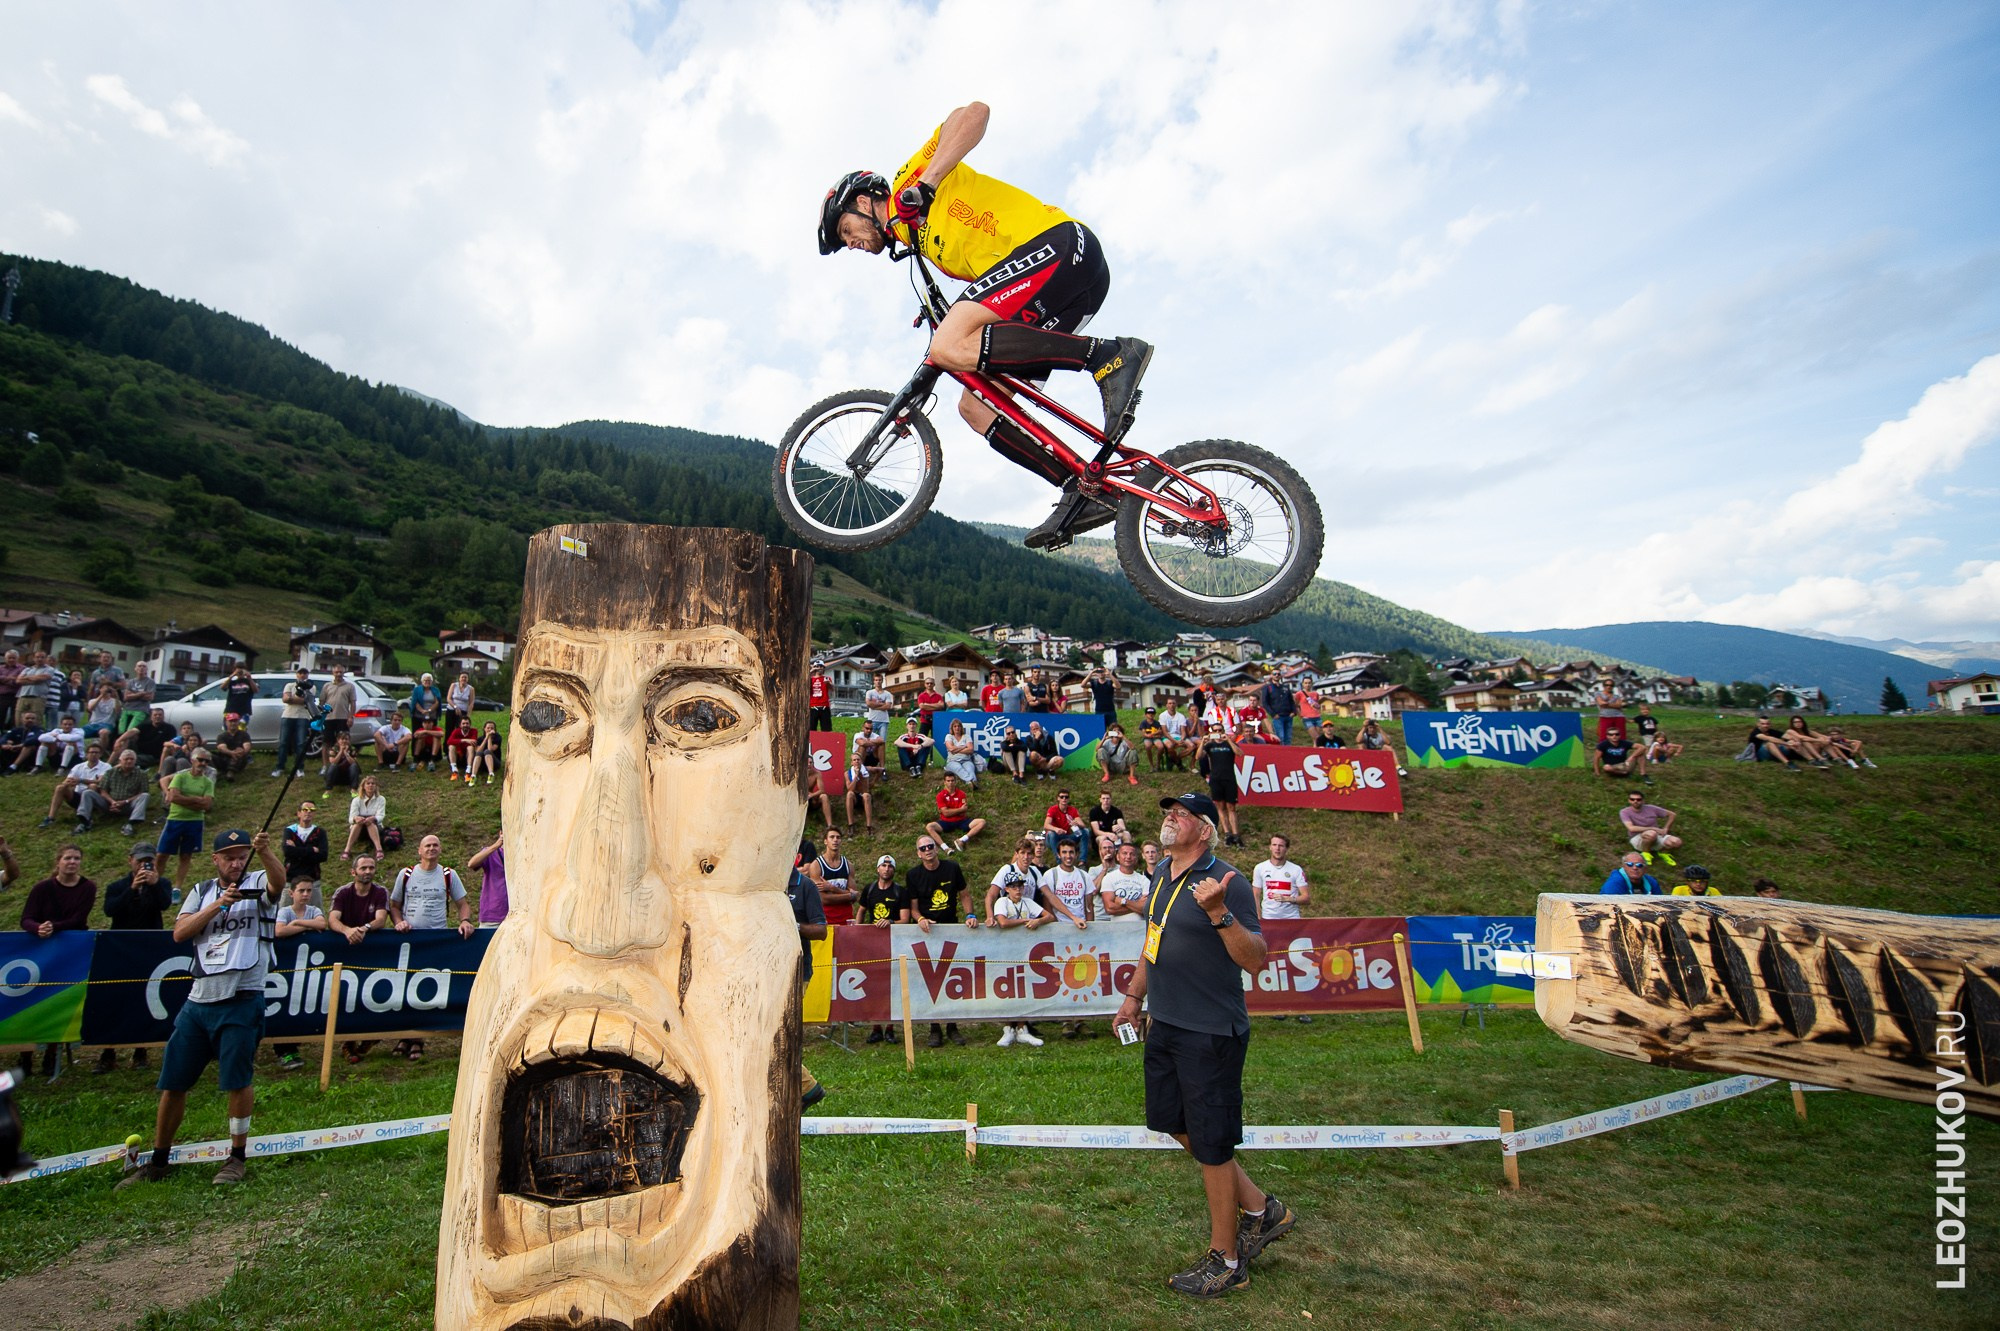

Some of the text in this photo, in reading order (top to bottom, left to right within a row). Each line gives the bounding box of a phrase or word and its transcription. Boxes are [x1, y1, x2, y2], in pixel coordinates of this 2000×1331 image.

[1234, 754, 1386, 796] Val di Sole
[911, 940, 1138, 1005] Val di Sole
[1258, 959, 1290, 992] di
[1288, 937, 1395, 992] Sole
